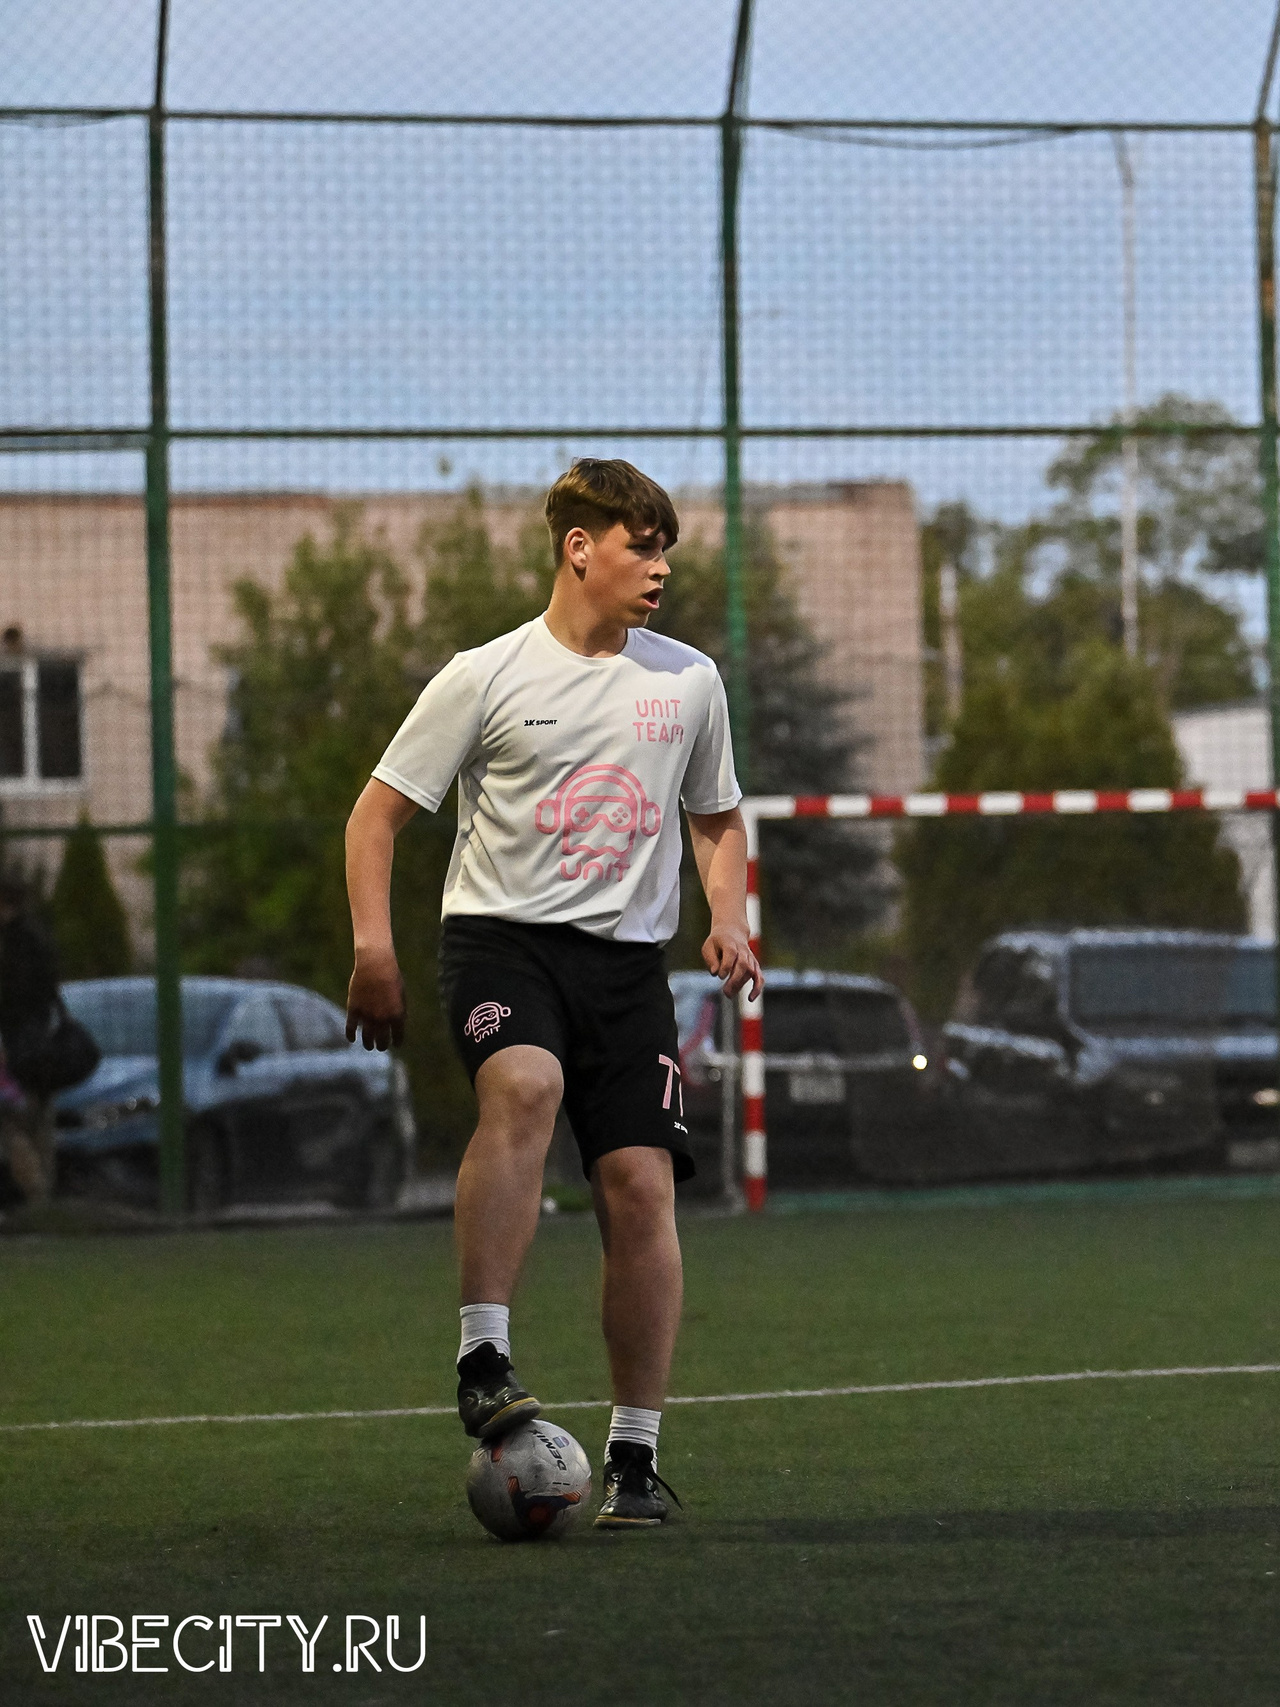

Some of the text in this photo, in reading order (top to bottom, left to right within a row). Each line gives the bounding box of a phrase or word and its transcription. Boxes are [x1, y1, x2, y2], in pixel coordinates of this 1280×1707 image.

[636, 698, 681, 719] UNIT
[632, 721, 684, 744] TEAM
[560, 860, 631, 883] UNIT
[474, 1024, 501, 1043] UNIT
[527, 1428, 567, 1471] DEMIX
